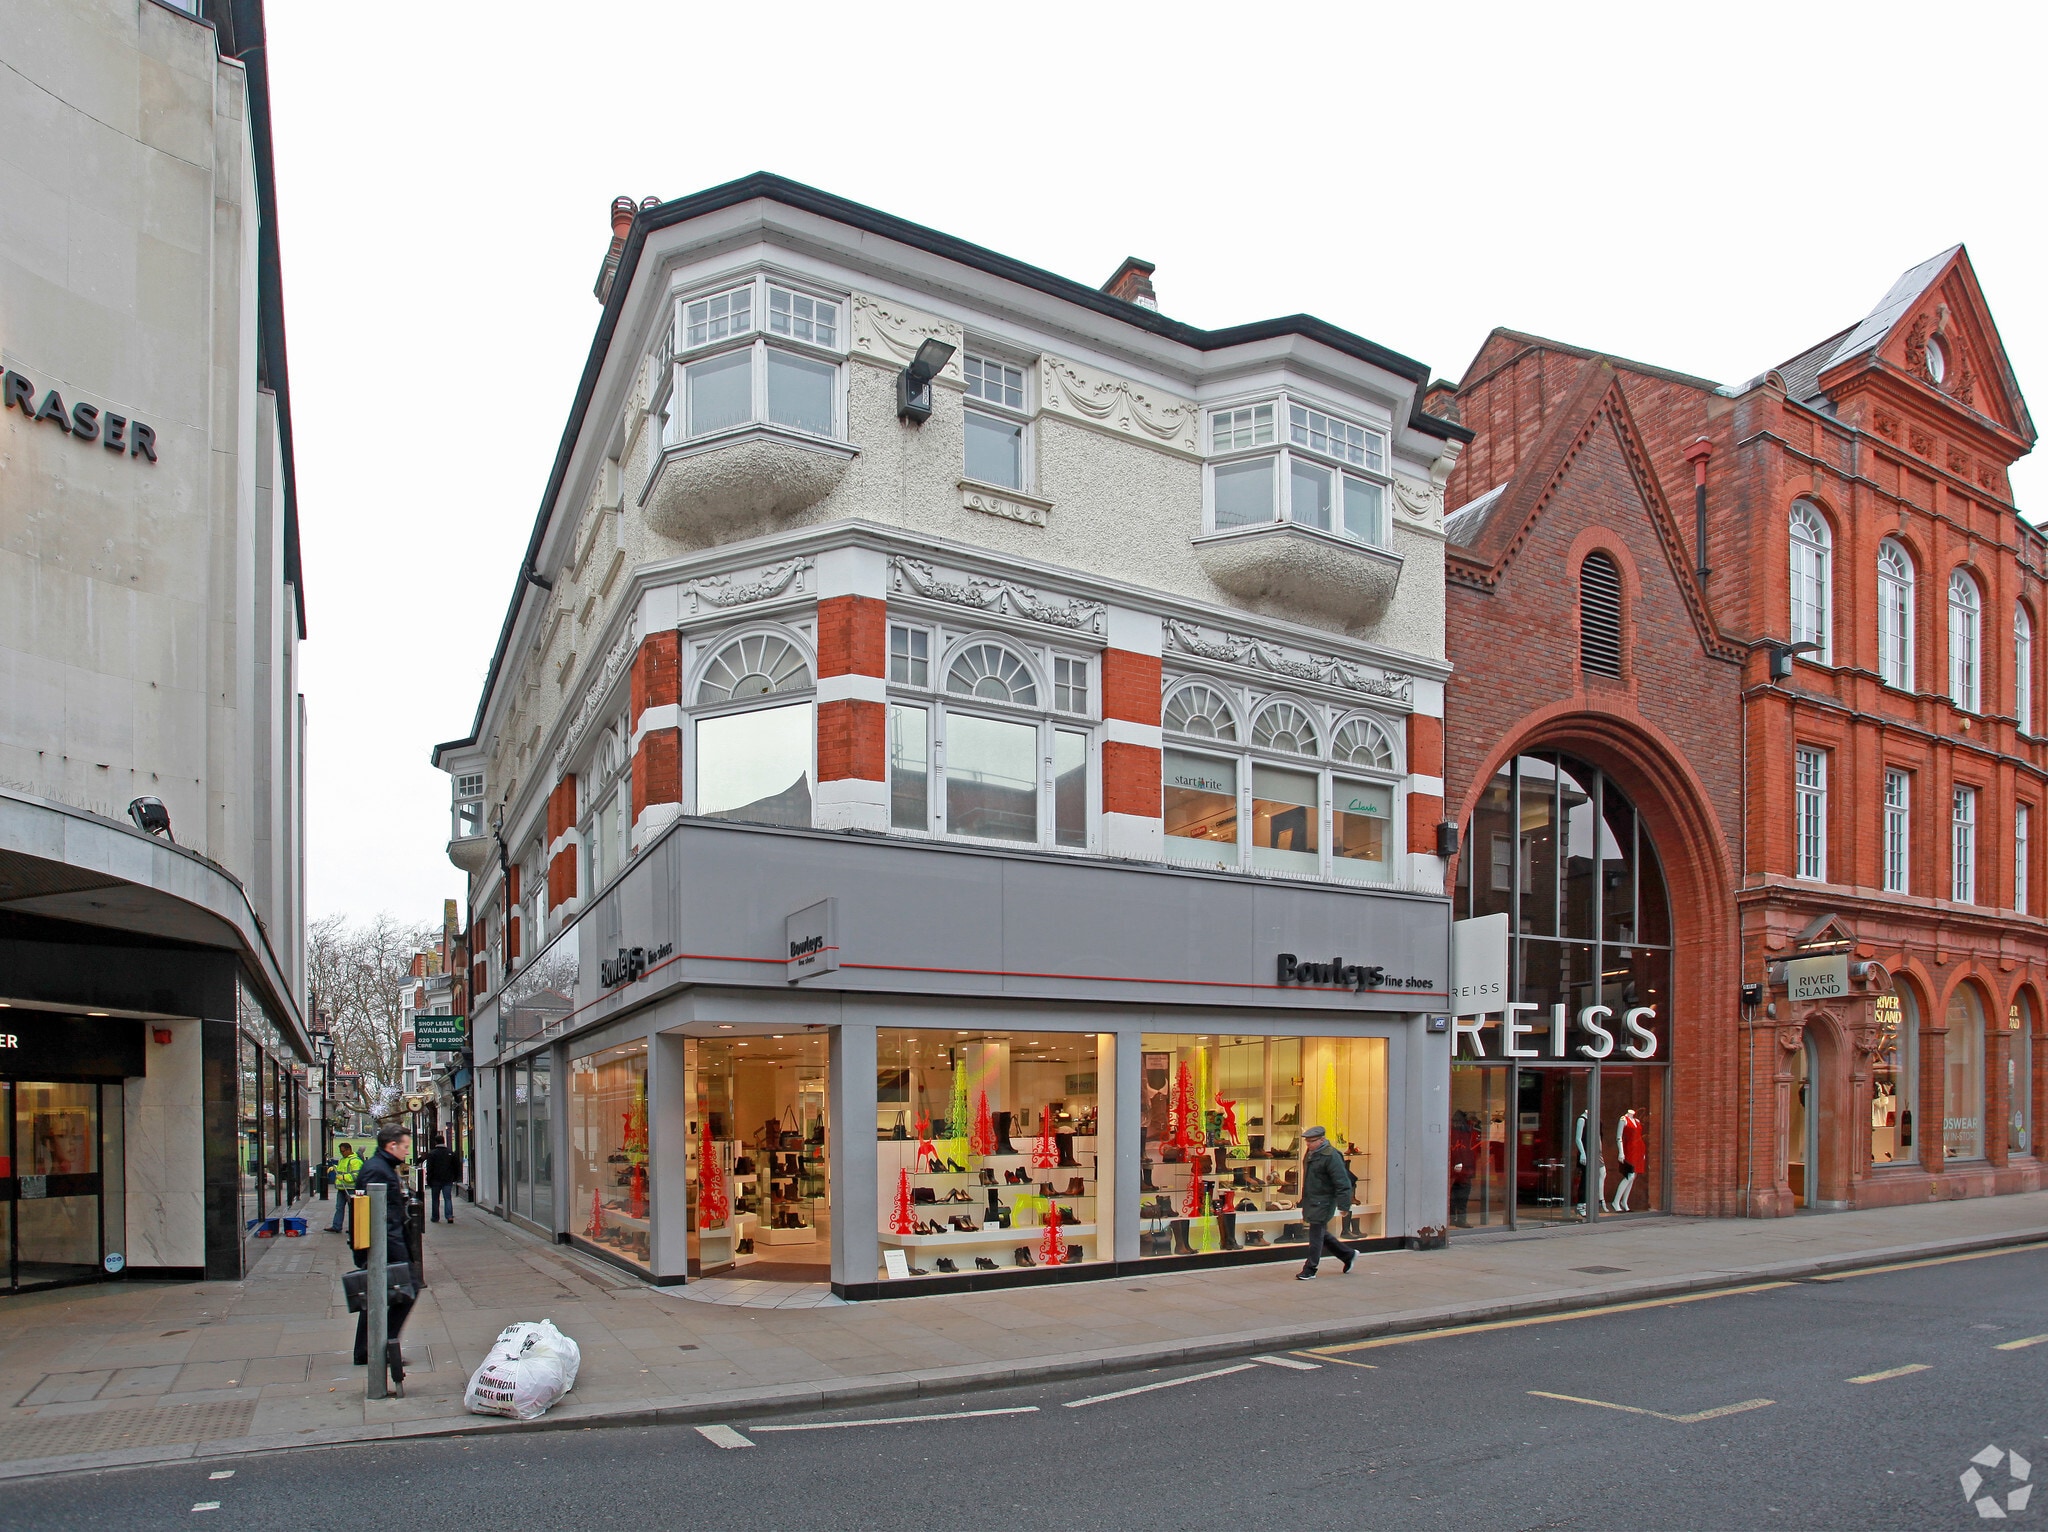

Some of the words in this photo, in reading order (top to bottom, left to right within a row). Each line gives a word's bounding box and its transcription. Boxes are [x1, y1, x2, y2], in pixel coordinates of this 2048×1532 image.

[0, 365, 157, 462] RASER
[1349, 799, 1376, 812] Clarks
[791, 936, 823, 957] Bowleys
[601, 946, 643, 988] Bowleys
[657, 942, 673, 960] shoes
[1277, 953, 1385, 993] Bowleys
[1385, 974, 1403, 988] fine
[1405, 976, 1434, 989] shoes
[1799, 973, 1835, 986] RIVER
[1795, 984, 1841, 998] ISLAND
[1875, 1010, 1902, 1024] SLAND
[1452, 1003, 1657, 1059] REISS
[475, 1386, 494, 1400] WASTE
[496, 1391, 514, 1402] ONLY
